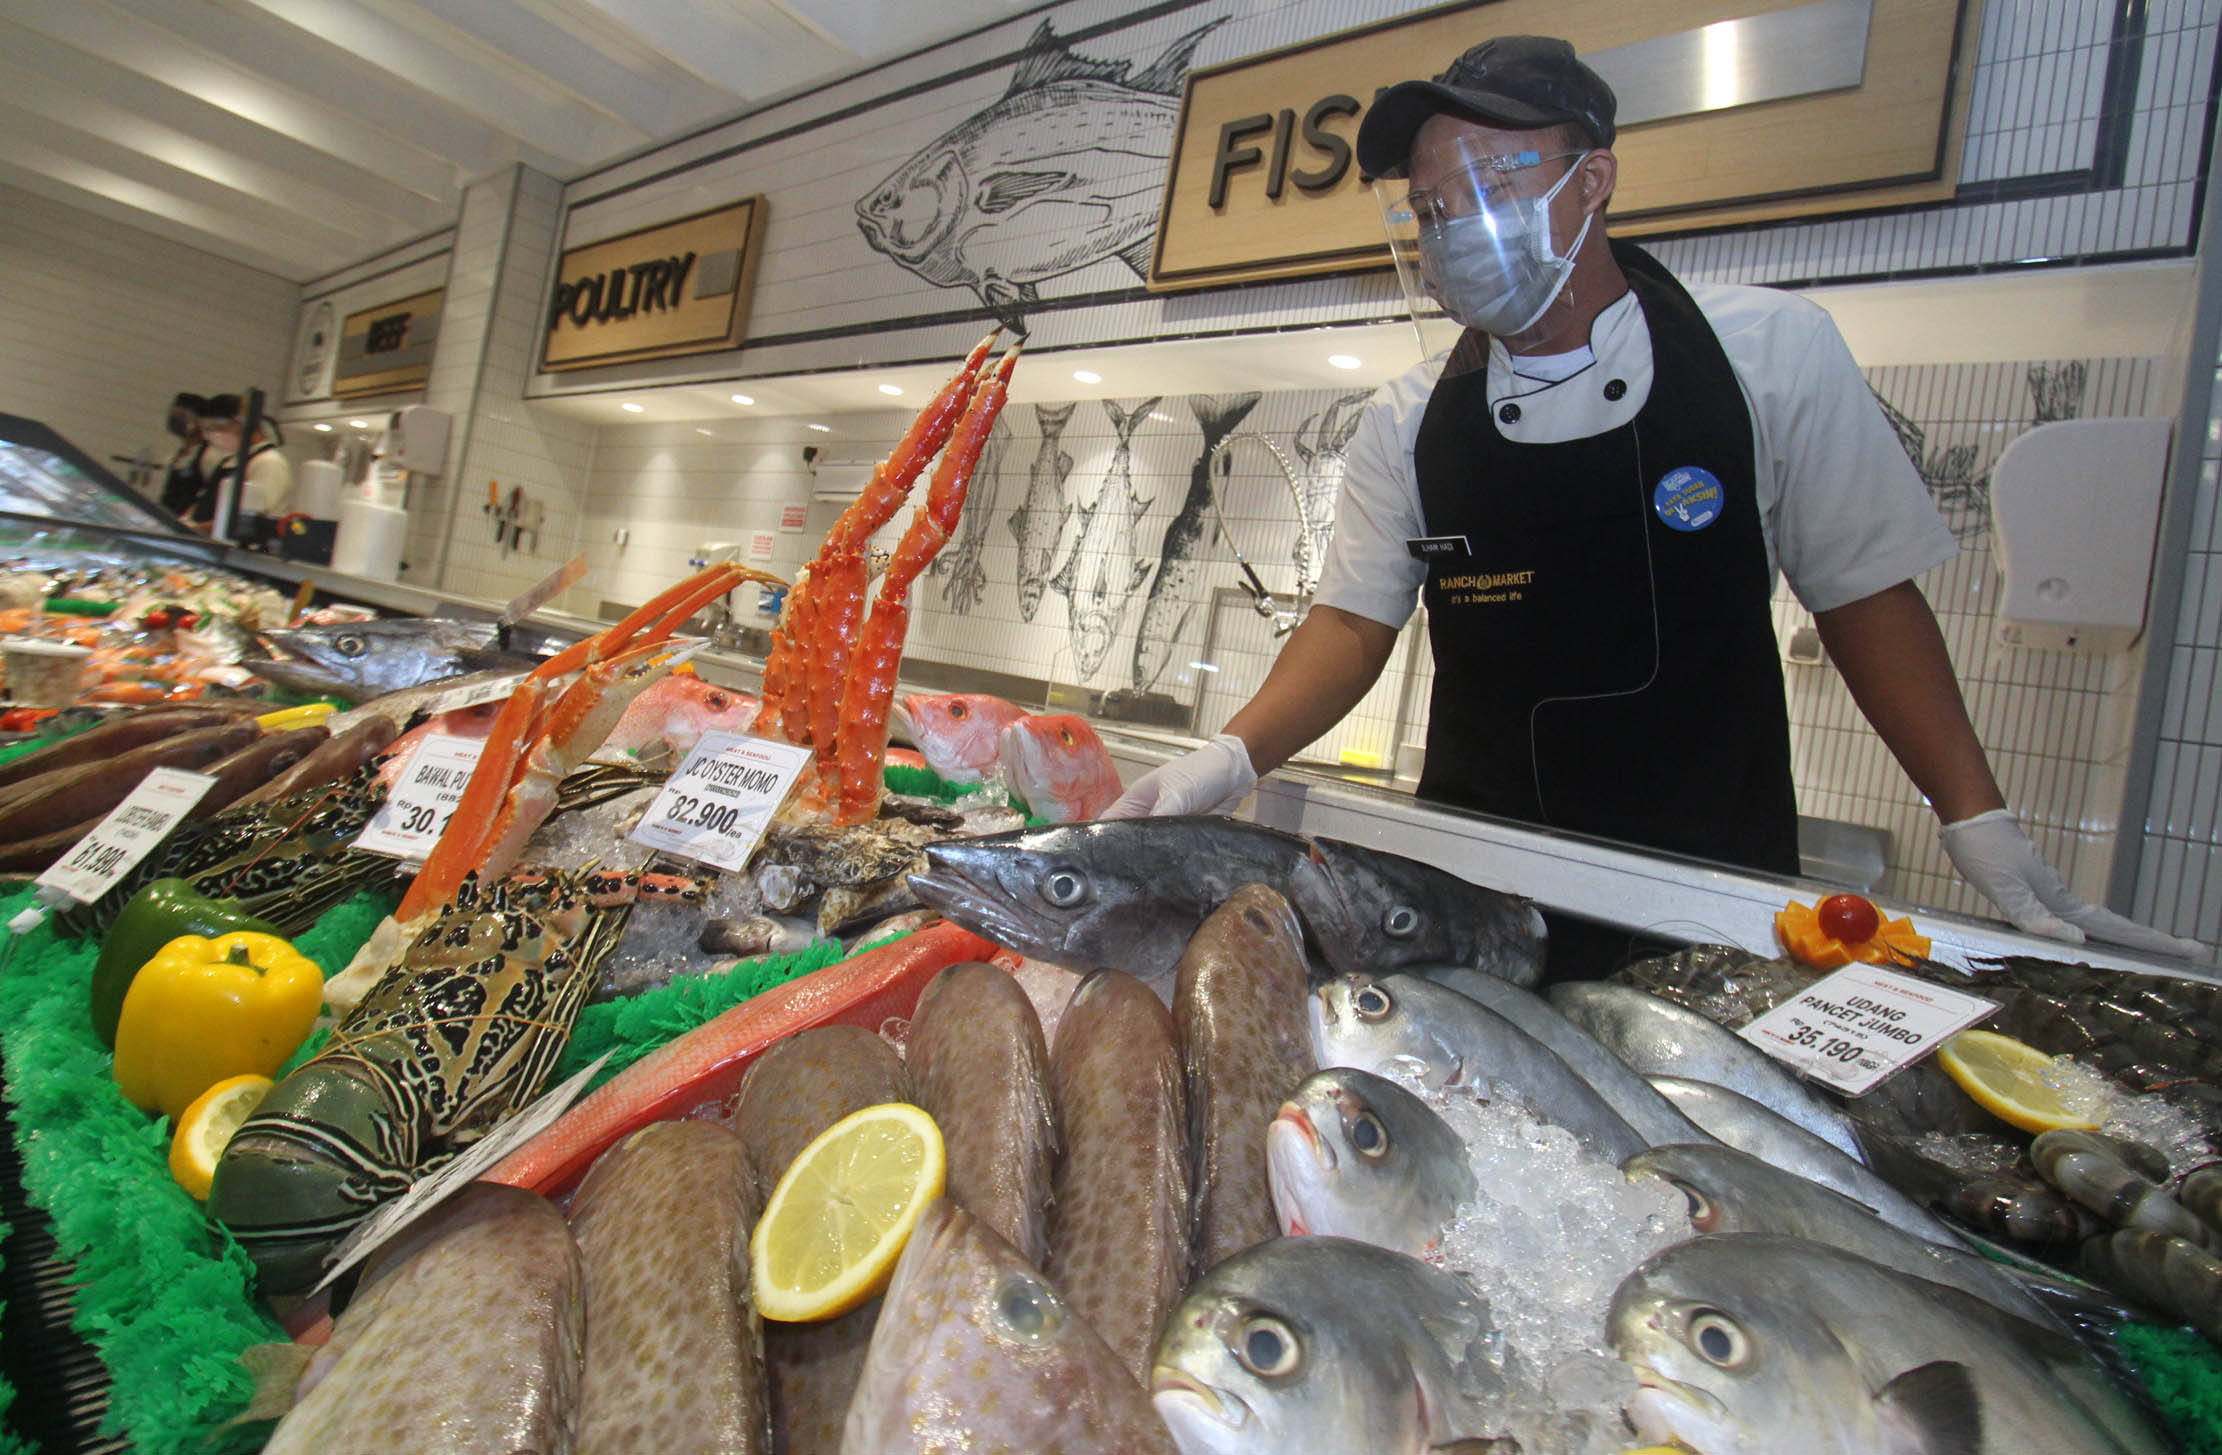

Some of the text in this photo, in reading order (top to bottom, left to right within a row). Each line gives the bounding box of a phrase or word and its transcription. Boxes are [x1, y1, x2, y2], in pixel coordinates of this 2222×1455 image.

[1208, 88, 1390, 209] FIS
[550, 252, 697, 331] POULTRY
[1440, 570, 1535, 591] RANCH MARKET
[1472, 591, 1507, 603] balanced
[1509, 591, 1523, 602] life
[414, 765, 472, 791] BAWAL PU
[686, 756, 708, 776] JC
[700, 760, 744, 786] OYSTER
[740, 768, 779, 795] MOMO
[401, 806, 453, 837] 30.1
[1800, 995, 1863, 1022] PANCET
[1858, 1018, 1922, 1045] JUMBO
[1846, 996, 1906, 1022] UDANG
